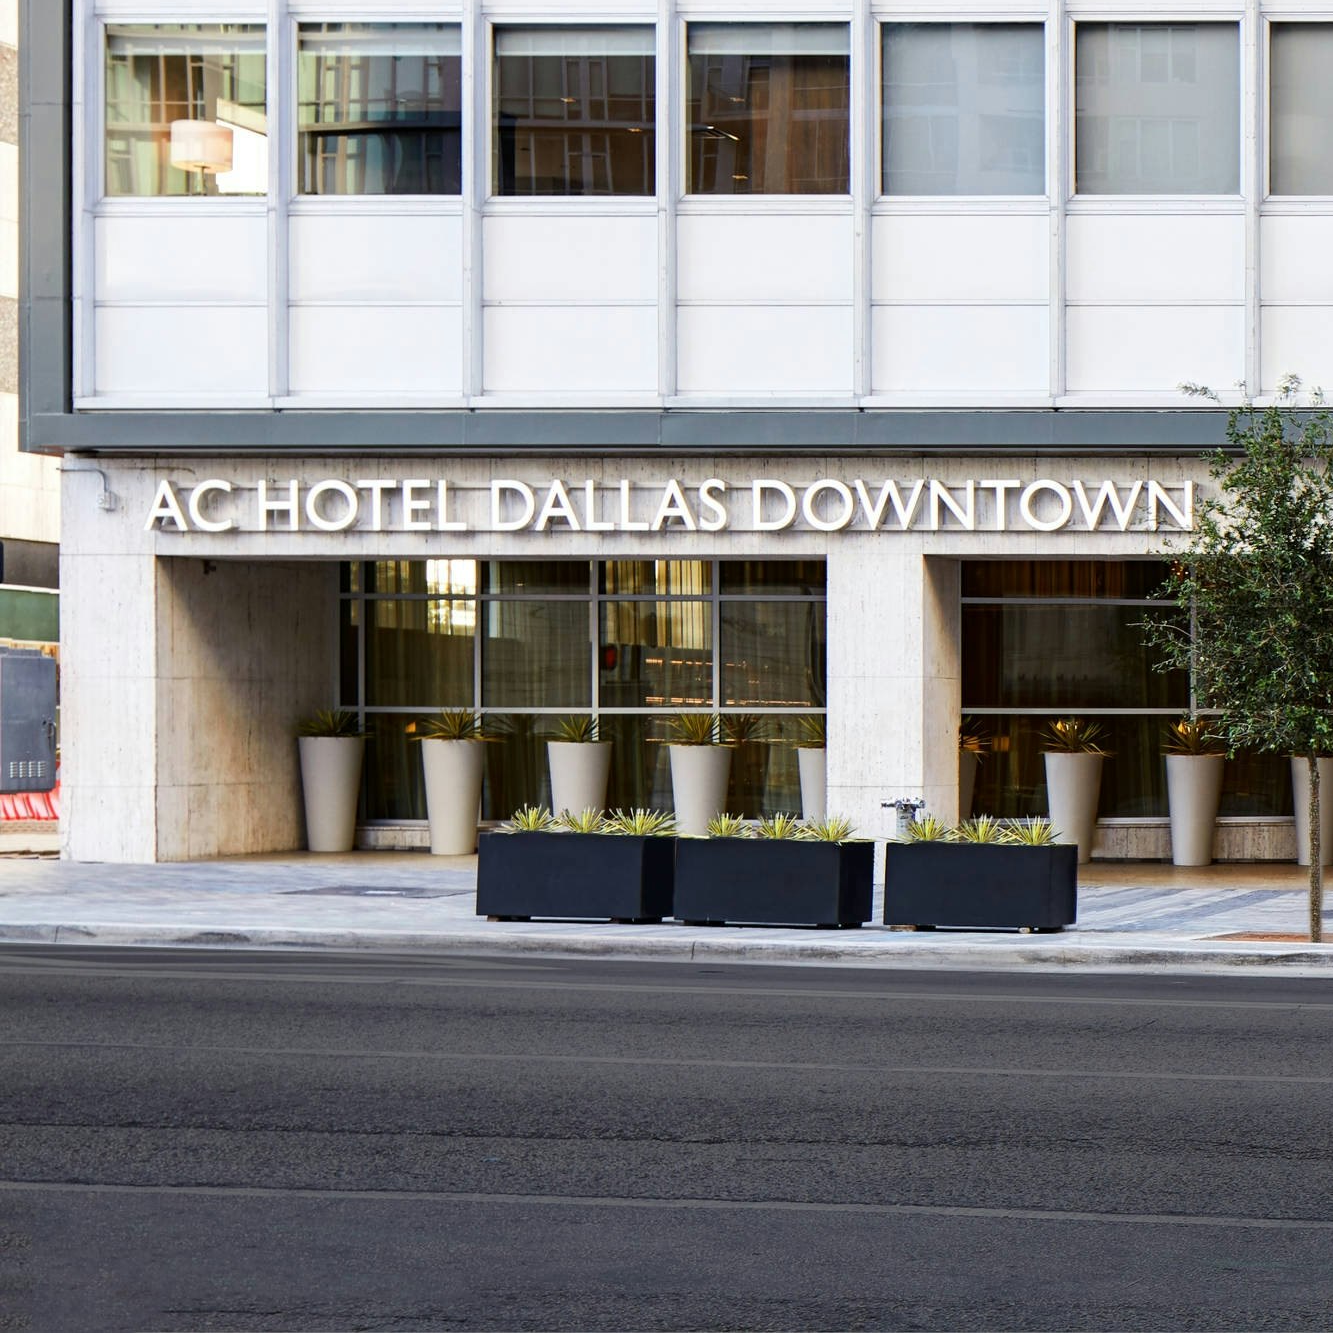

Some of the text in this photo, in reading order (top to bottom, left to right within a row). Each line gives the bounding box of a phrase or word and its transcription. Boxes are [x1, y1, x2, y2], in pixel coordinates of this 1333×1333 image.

[144, 478, 1194, 532] AC HOTEL DALLAS DOWNTOWN
